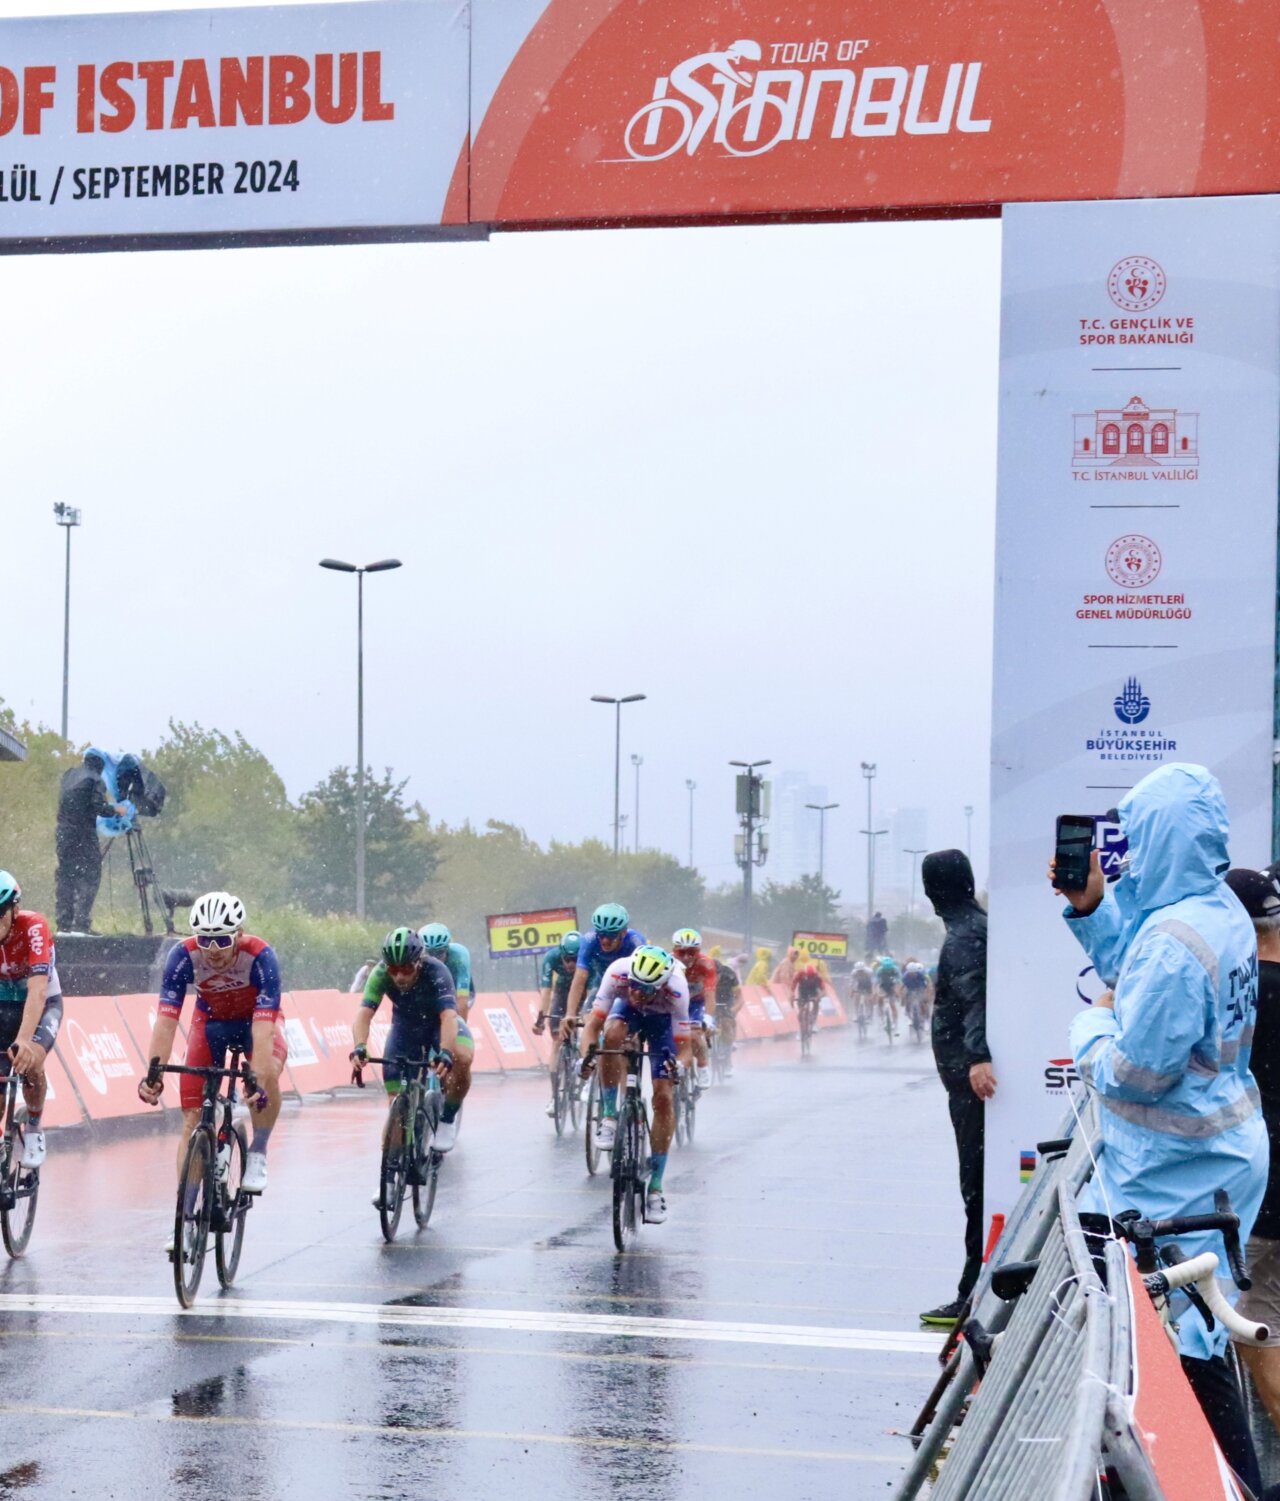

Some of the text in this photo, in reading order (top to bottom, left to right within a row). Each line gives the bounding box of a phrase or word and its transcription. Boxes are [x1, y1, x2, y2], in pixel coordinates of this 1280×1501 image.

[768, 39, 870, 65] TOUR OF
[76, 50, 396, 134] ISTANBUL
[49, 166, 66, 202] /
[72, 161, 225, 200] SEPTEMBER
[234, 159, 301, 195] 2024
[1079, 316, 1194, 332] T.C. GENÇLİK VE
[1079, 331, 1194, 345] SPOR BAKANLIĞI
[1094, 469, 1149, 481] İSTANBUL
[1152, 469, 1199, 481] VALİLİĞİ
[1083, 593, 1185, 605] SPOR HİZMETLERİ
[1075, 607, 1193, 620] GENEL MÜDÜRLÜĞÜ
[1086, 738, 1177, 753] BÜYÜKŞEHİR
[28, 924, 44, 956] lotto
[507, 927, 563, 949] 50 m
